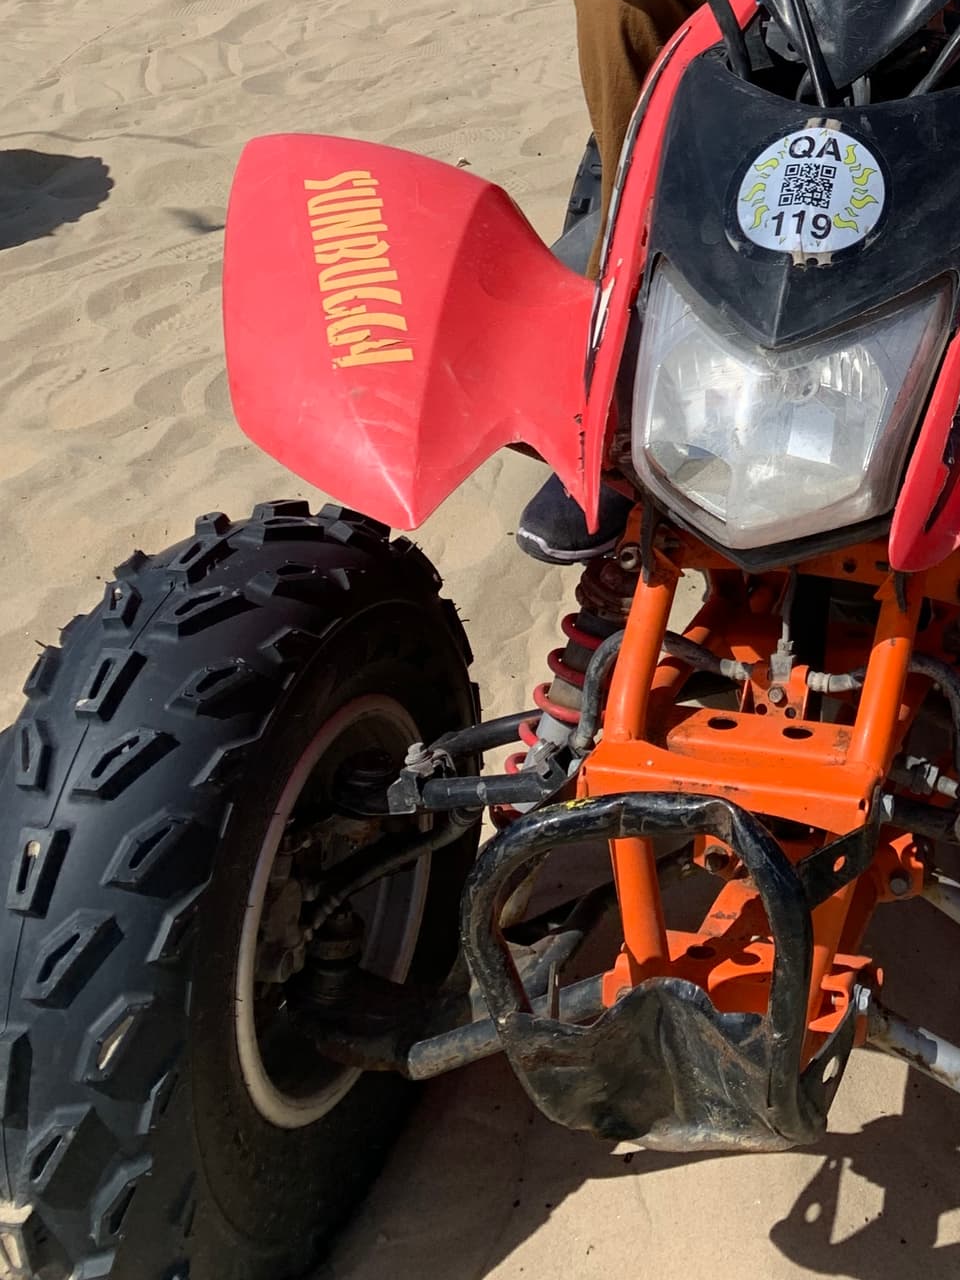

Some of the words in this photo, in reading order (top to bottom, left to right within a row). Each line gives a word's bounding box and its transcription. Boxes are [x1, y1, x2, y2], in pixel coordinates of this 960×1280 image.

[788, 134, 843, 162] QA
[771, 209, 833, 240] 119
[303, 169, 415, 370] SUNBUGGY
